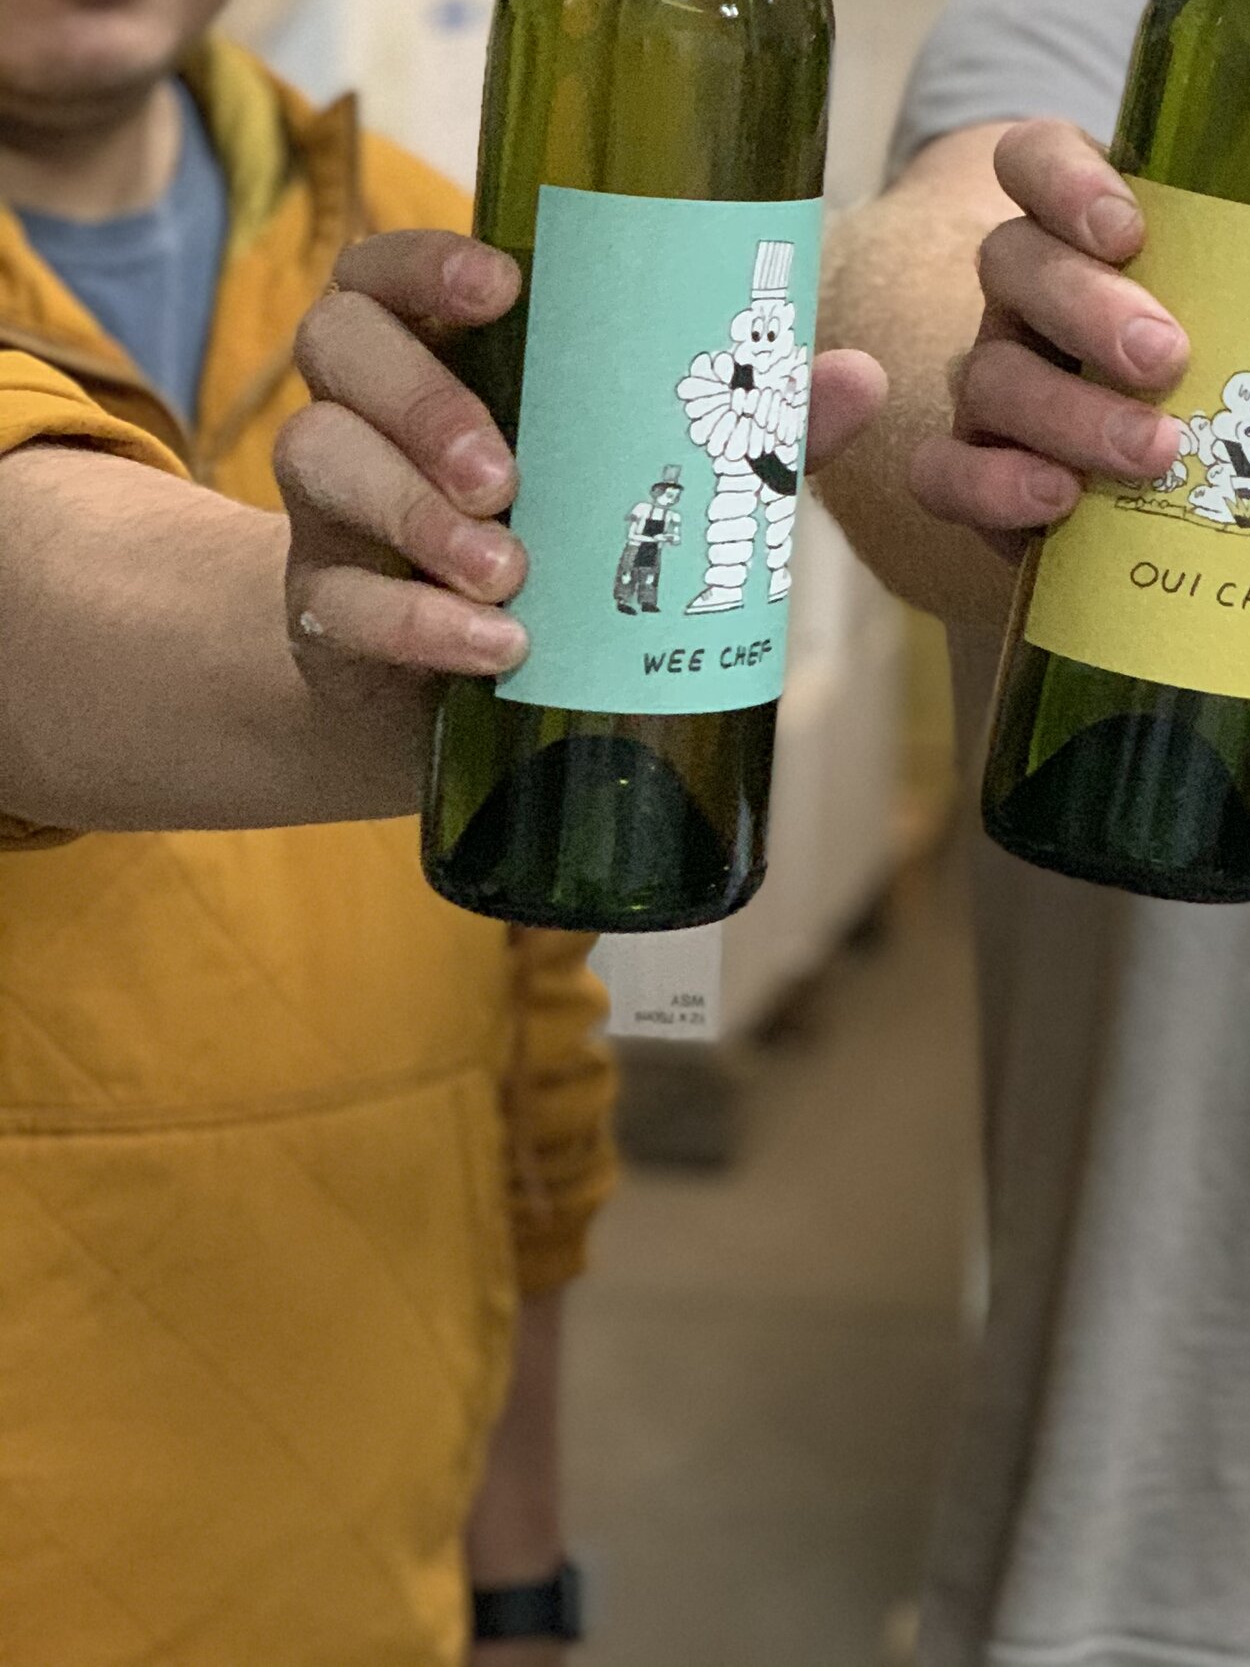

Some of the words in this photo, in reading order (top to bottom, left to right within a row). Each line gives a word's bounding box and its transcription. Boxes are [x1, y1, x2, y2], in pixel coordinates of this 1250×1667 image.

[1129, 561, 1203, 597] OUI
[643, 648, 706, 676] WEE
[719, 638, 773, 670] CHEF
